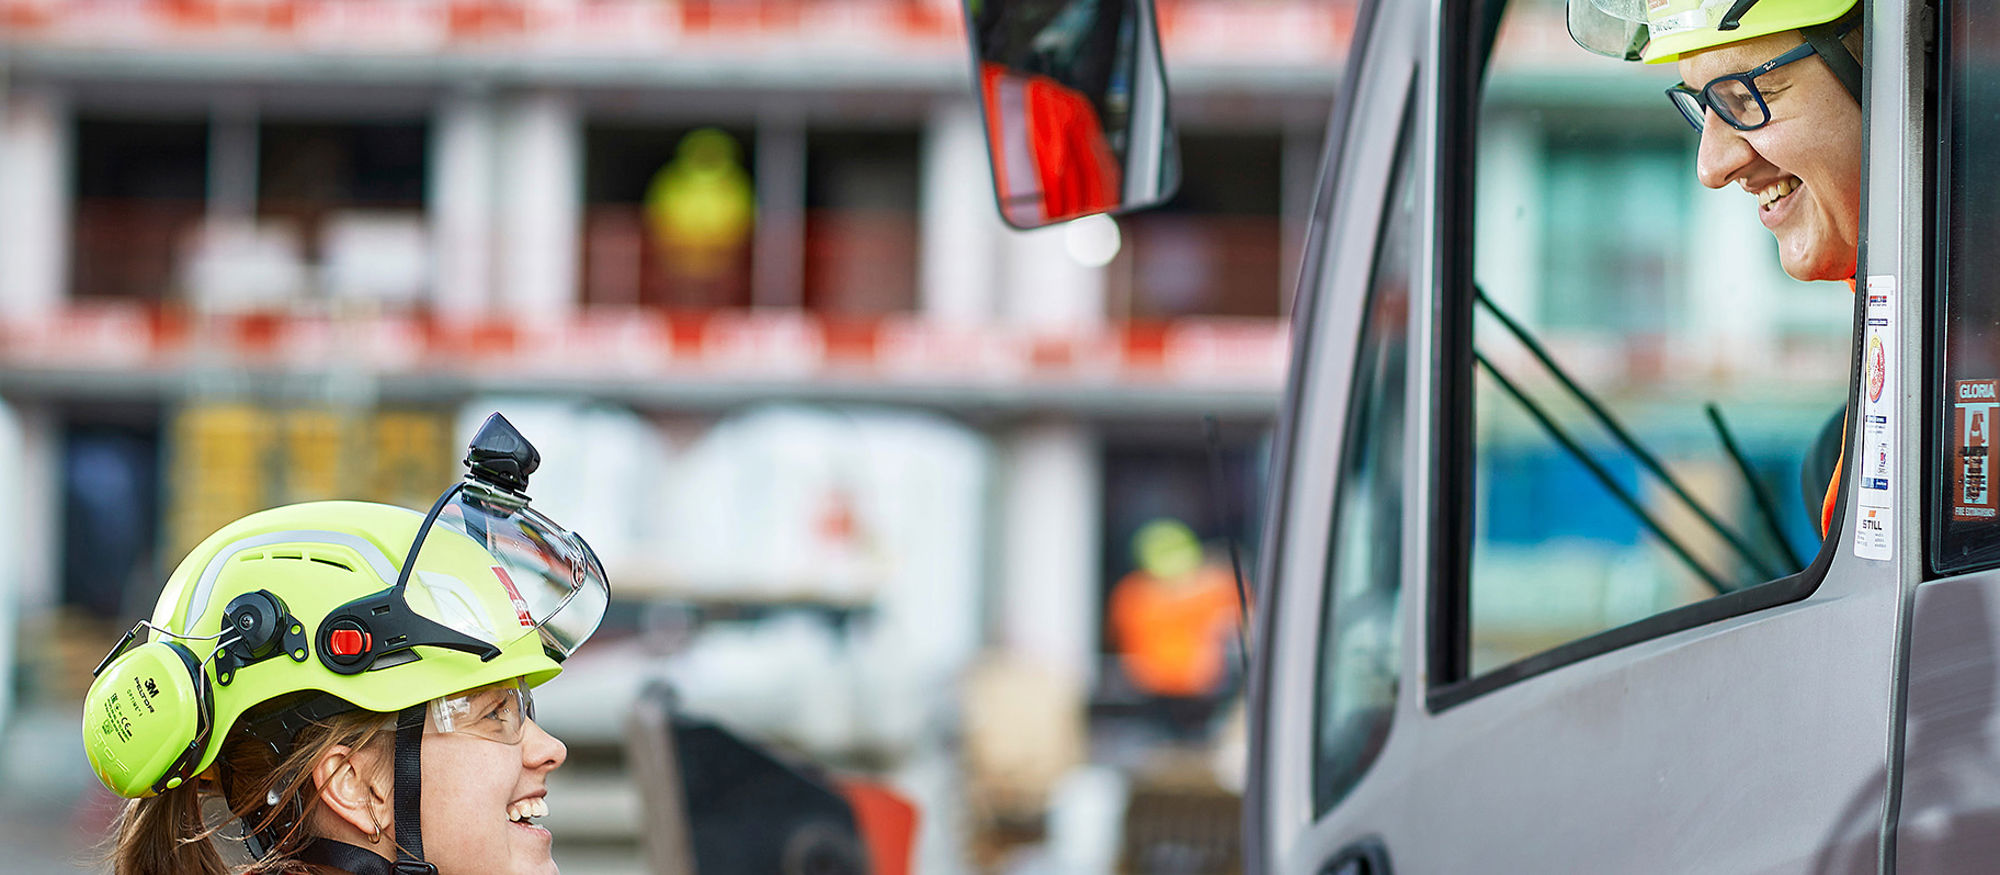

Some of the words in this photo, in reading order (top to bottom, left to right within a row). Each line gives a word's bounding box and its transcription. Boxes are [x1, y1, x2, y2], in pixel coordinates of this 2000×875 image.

[1960, 383, 1996, 399] GLORIA
[1862, 519, 1883, 531] STILL
[134, 676, 155, 714] PELTOR
[145, 678, 159, 698] 3M
